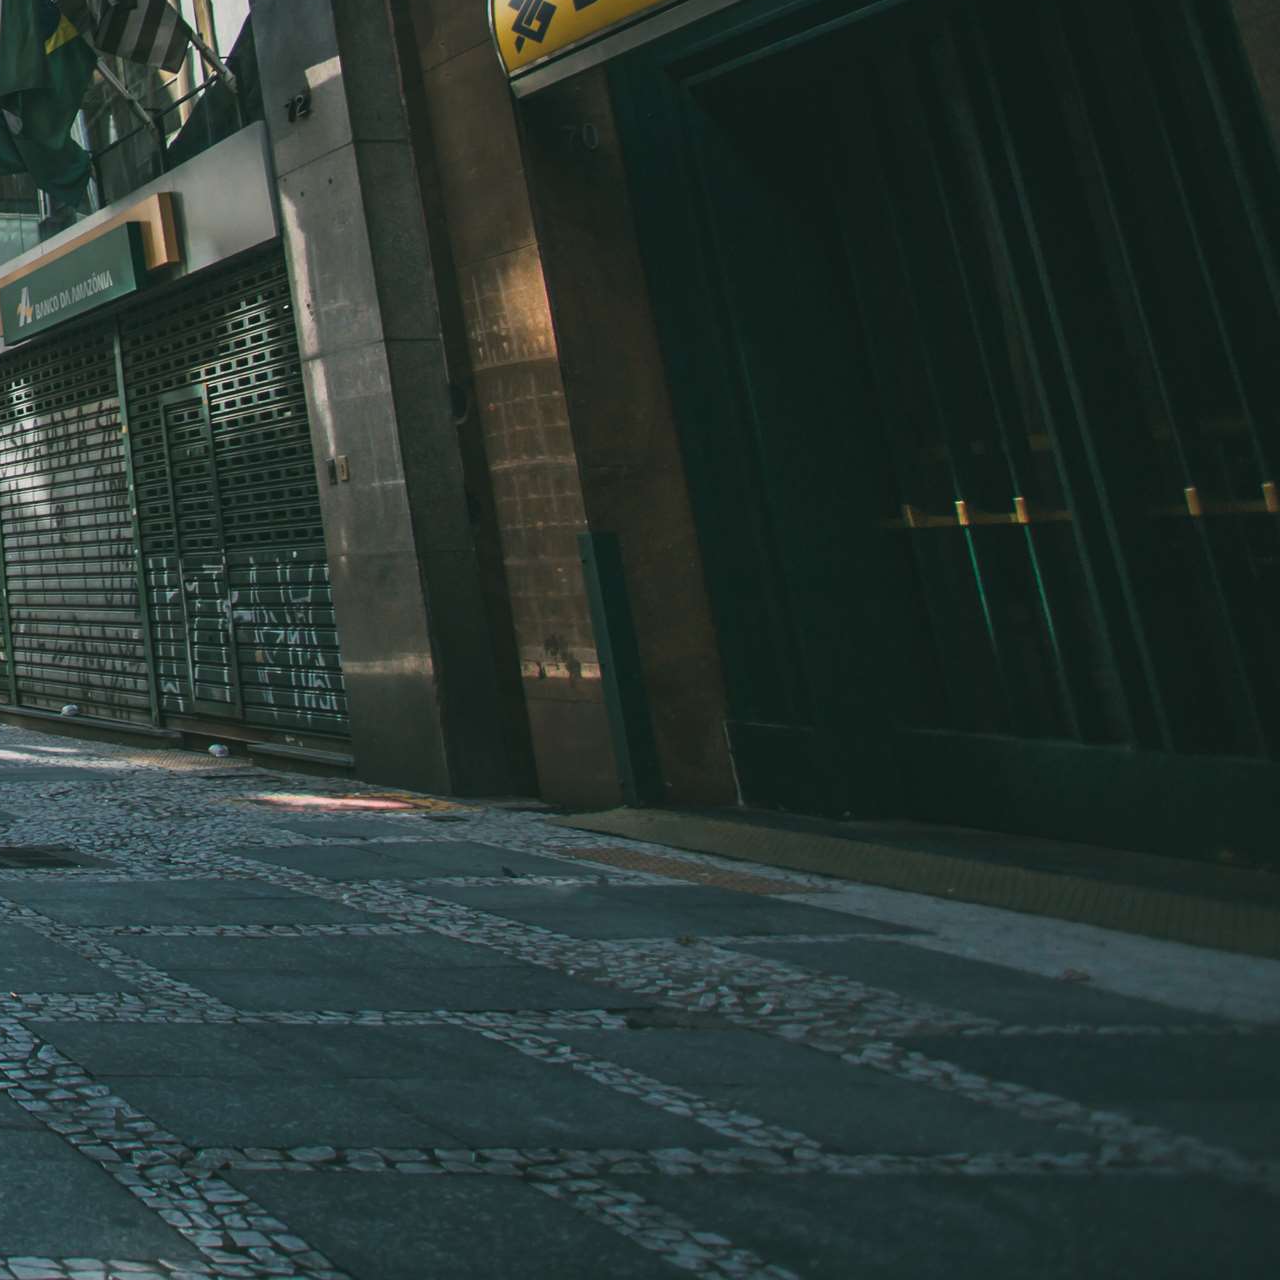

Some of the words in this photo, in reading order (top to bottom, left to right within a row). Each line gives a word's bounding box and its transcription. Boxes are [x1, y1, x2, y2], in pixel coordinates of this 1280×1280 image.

[34, 295, 60, 321] BANCO
[59, 289, 72, 309] DA
[71, 269, 113, 303] AMAZÔNIA
